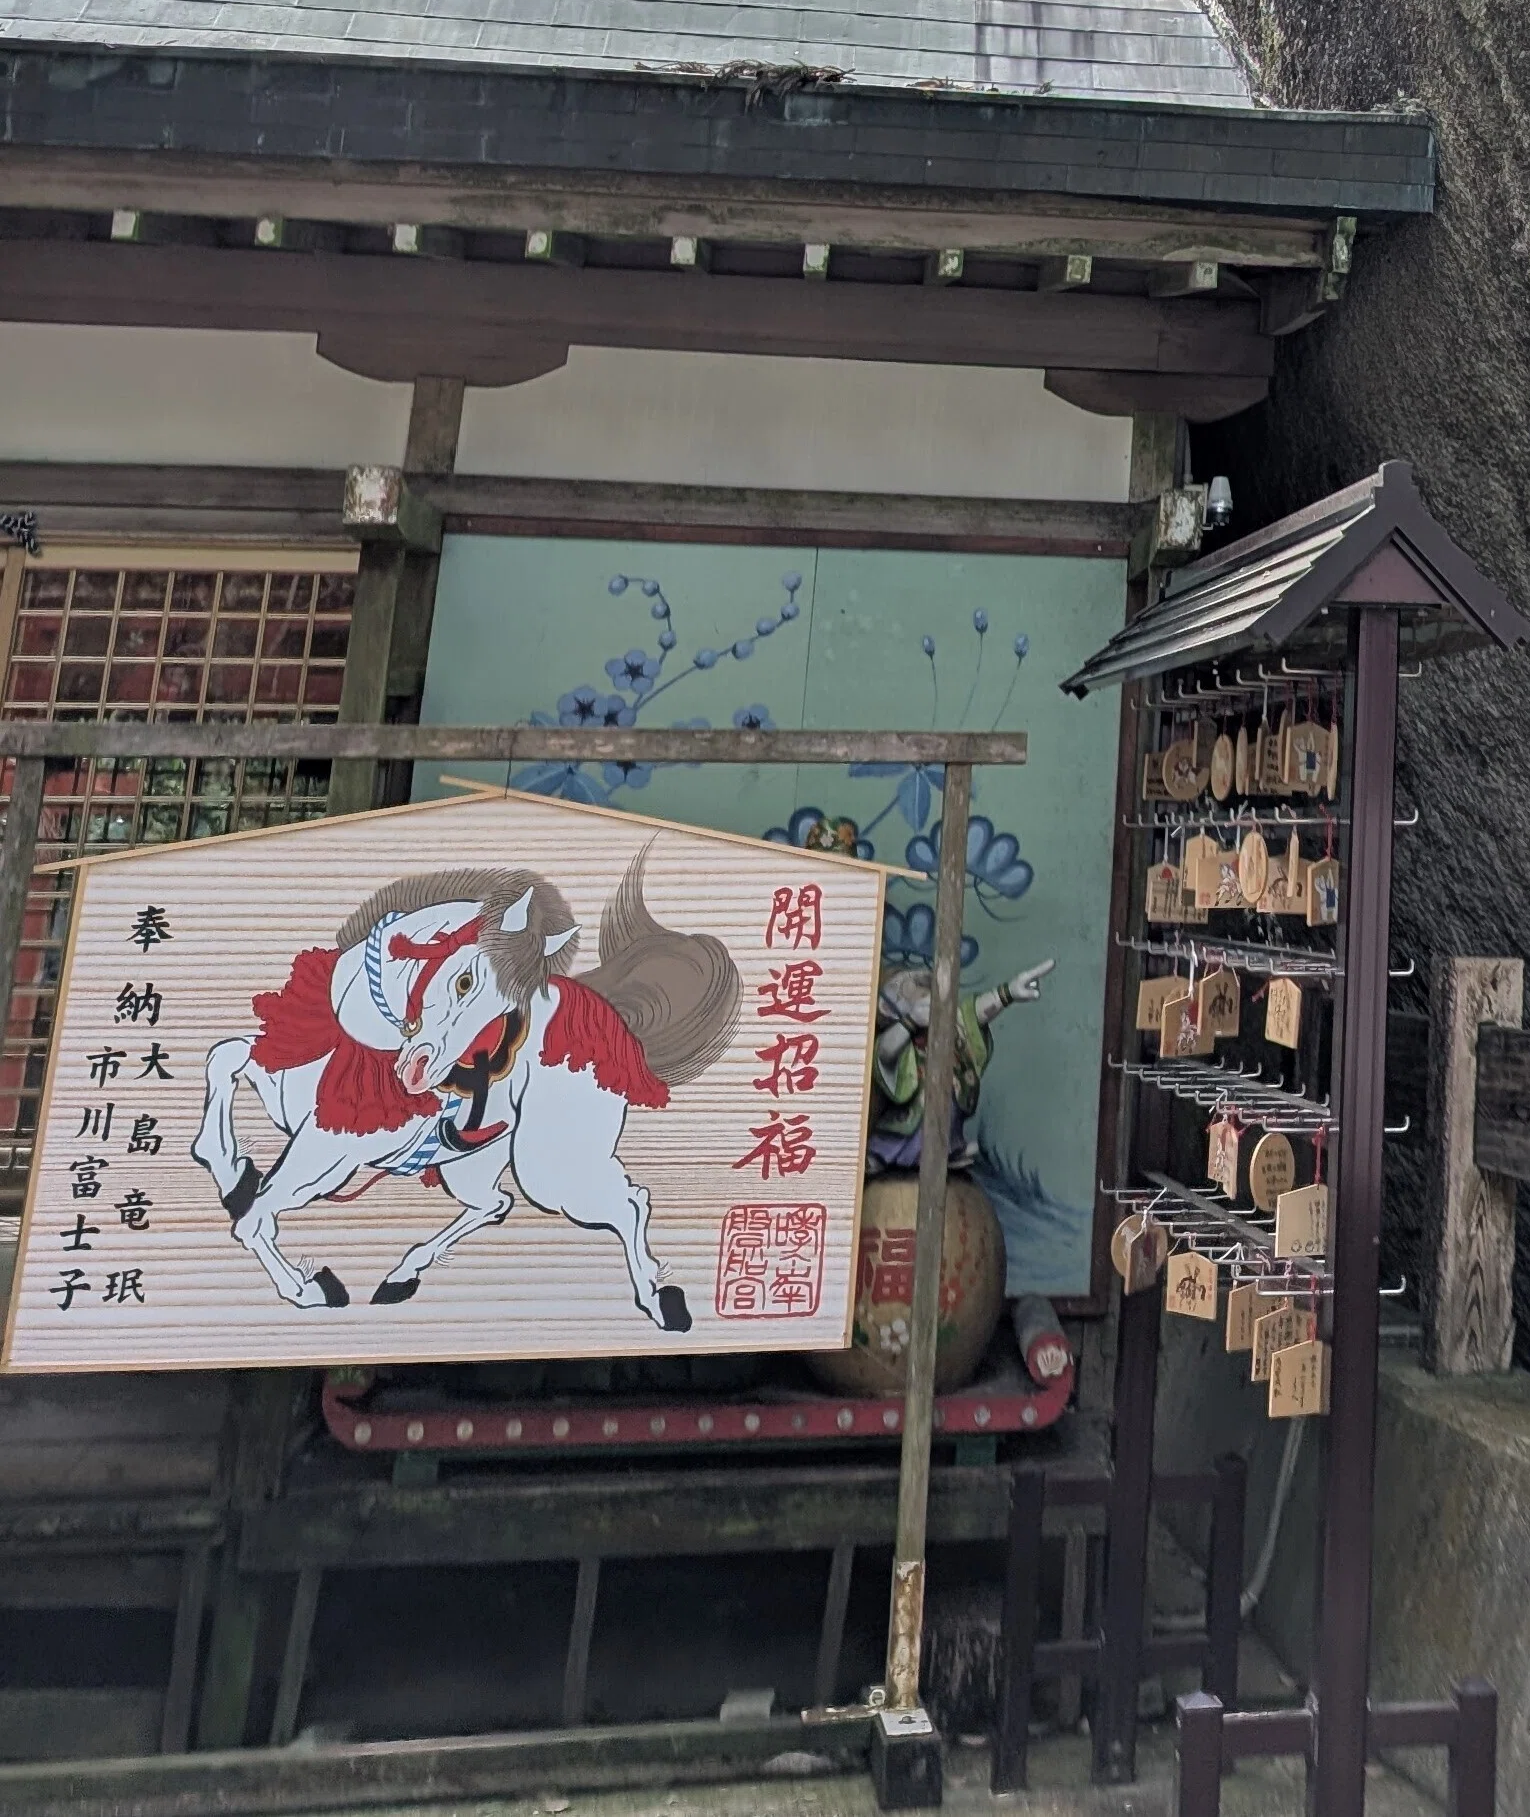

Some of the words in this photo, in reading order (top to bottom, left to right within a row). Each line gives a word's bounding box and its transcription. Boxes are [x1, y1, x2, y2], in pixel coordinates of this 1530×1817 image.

[114, 905, 174, 1027] 奉納
[732, 884, 831, 1180] 開運招福
[48, 1046, 128, 1312] 市川富士子
[856, 1228, 916, 1305] 福
